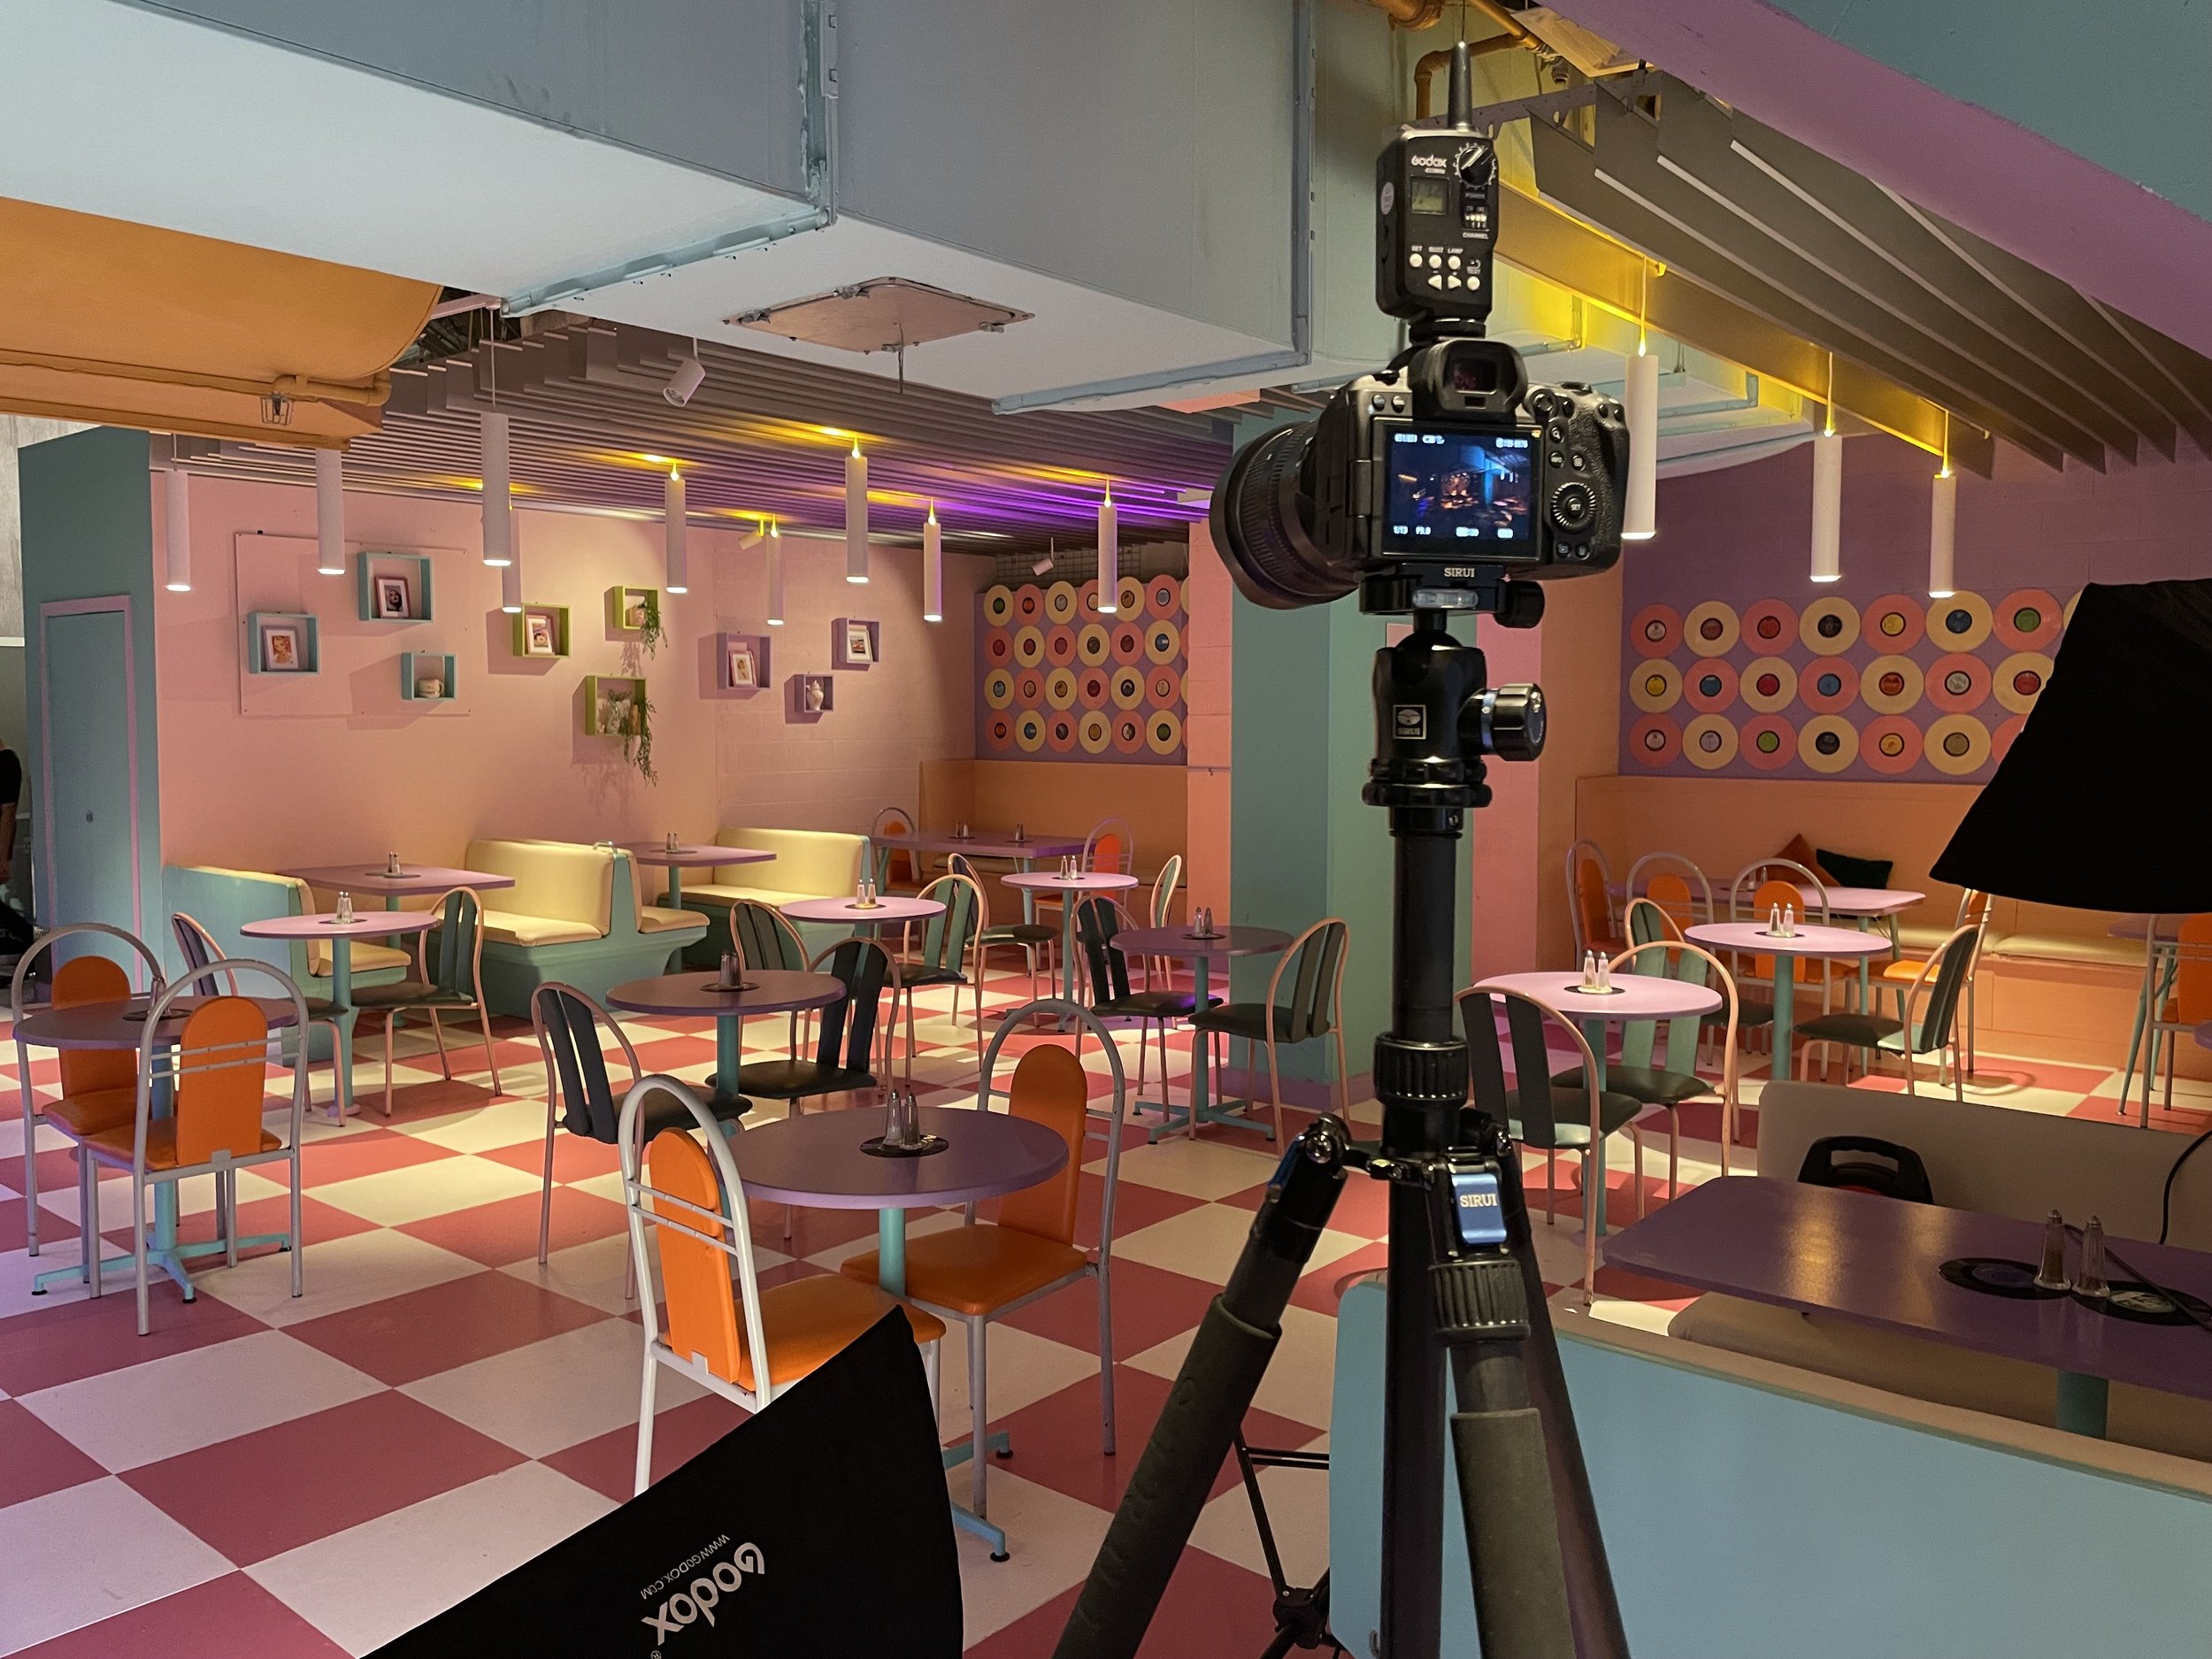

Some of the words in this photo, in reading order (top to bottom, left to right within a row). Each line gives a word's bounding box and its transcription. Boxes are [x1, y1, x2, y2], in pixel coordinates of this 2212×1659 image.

[1411, 154, 1447, 168] Godox
[1444, 567, 1475, 578] SIRUI
[1459, 1193, 1498, 1208] SIRUI
[640, 1534, 731, 1600] WWW.GODOX.COM
[641, 1541, 765, 1647] Godox
